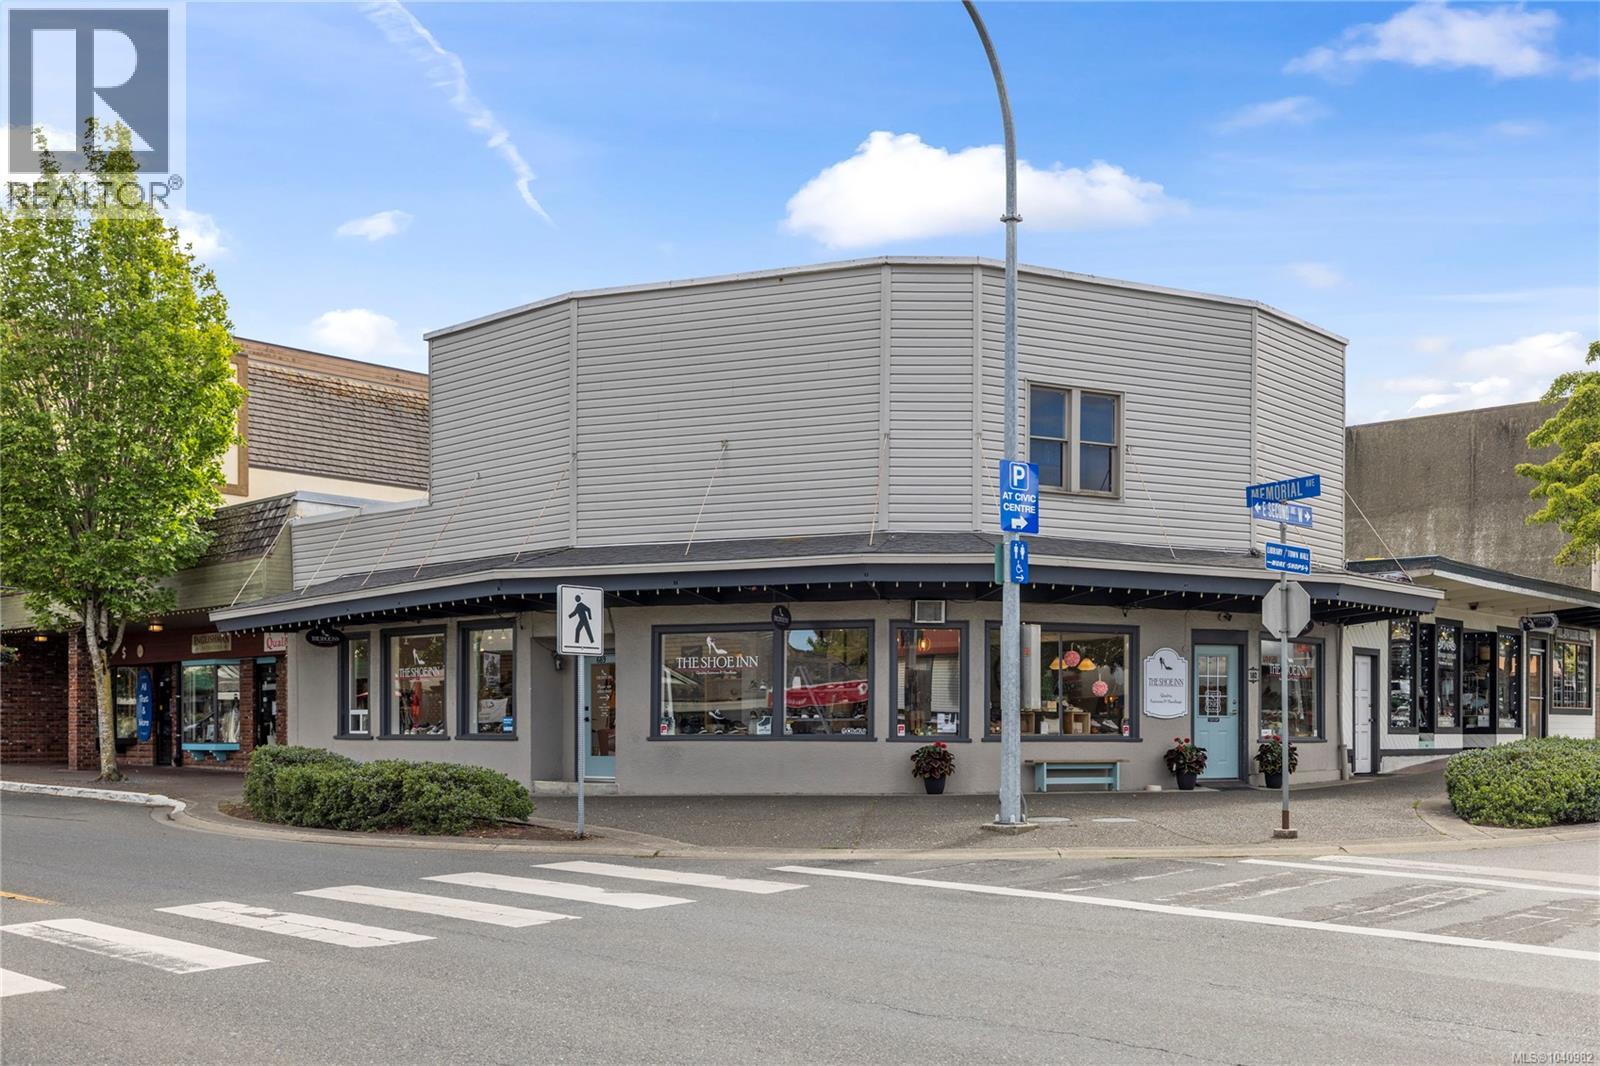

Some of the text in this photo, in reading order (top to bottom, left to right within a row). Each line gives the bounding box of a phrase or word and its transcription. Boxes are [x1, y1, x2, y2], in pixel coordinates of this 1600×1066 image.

[1013, 465, 1025, 486] P
[1251, 479, 1315, 501] MEMORIAL AVE
[1003, 492, 1037, 503] AT CIVIC
[1003, 503, 1036, 514] CENTRE
[1262, 502, 1266, 517] E
[1267, 502, 1289, 520] SECOND
[1288, 550, 1299, 558] TOWN
[1272, 560, 1305, 571] MORE SHOPS
[676, 656, 759, 669] THE SHOE INN
[1149, 678, 1184, 687] THE SHOE INN
